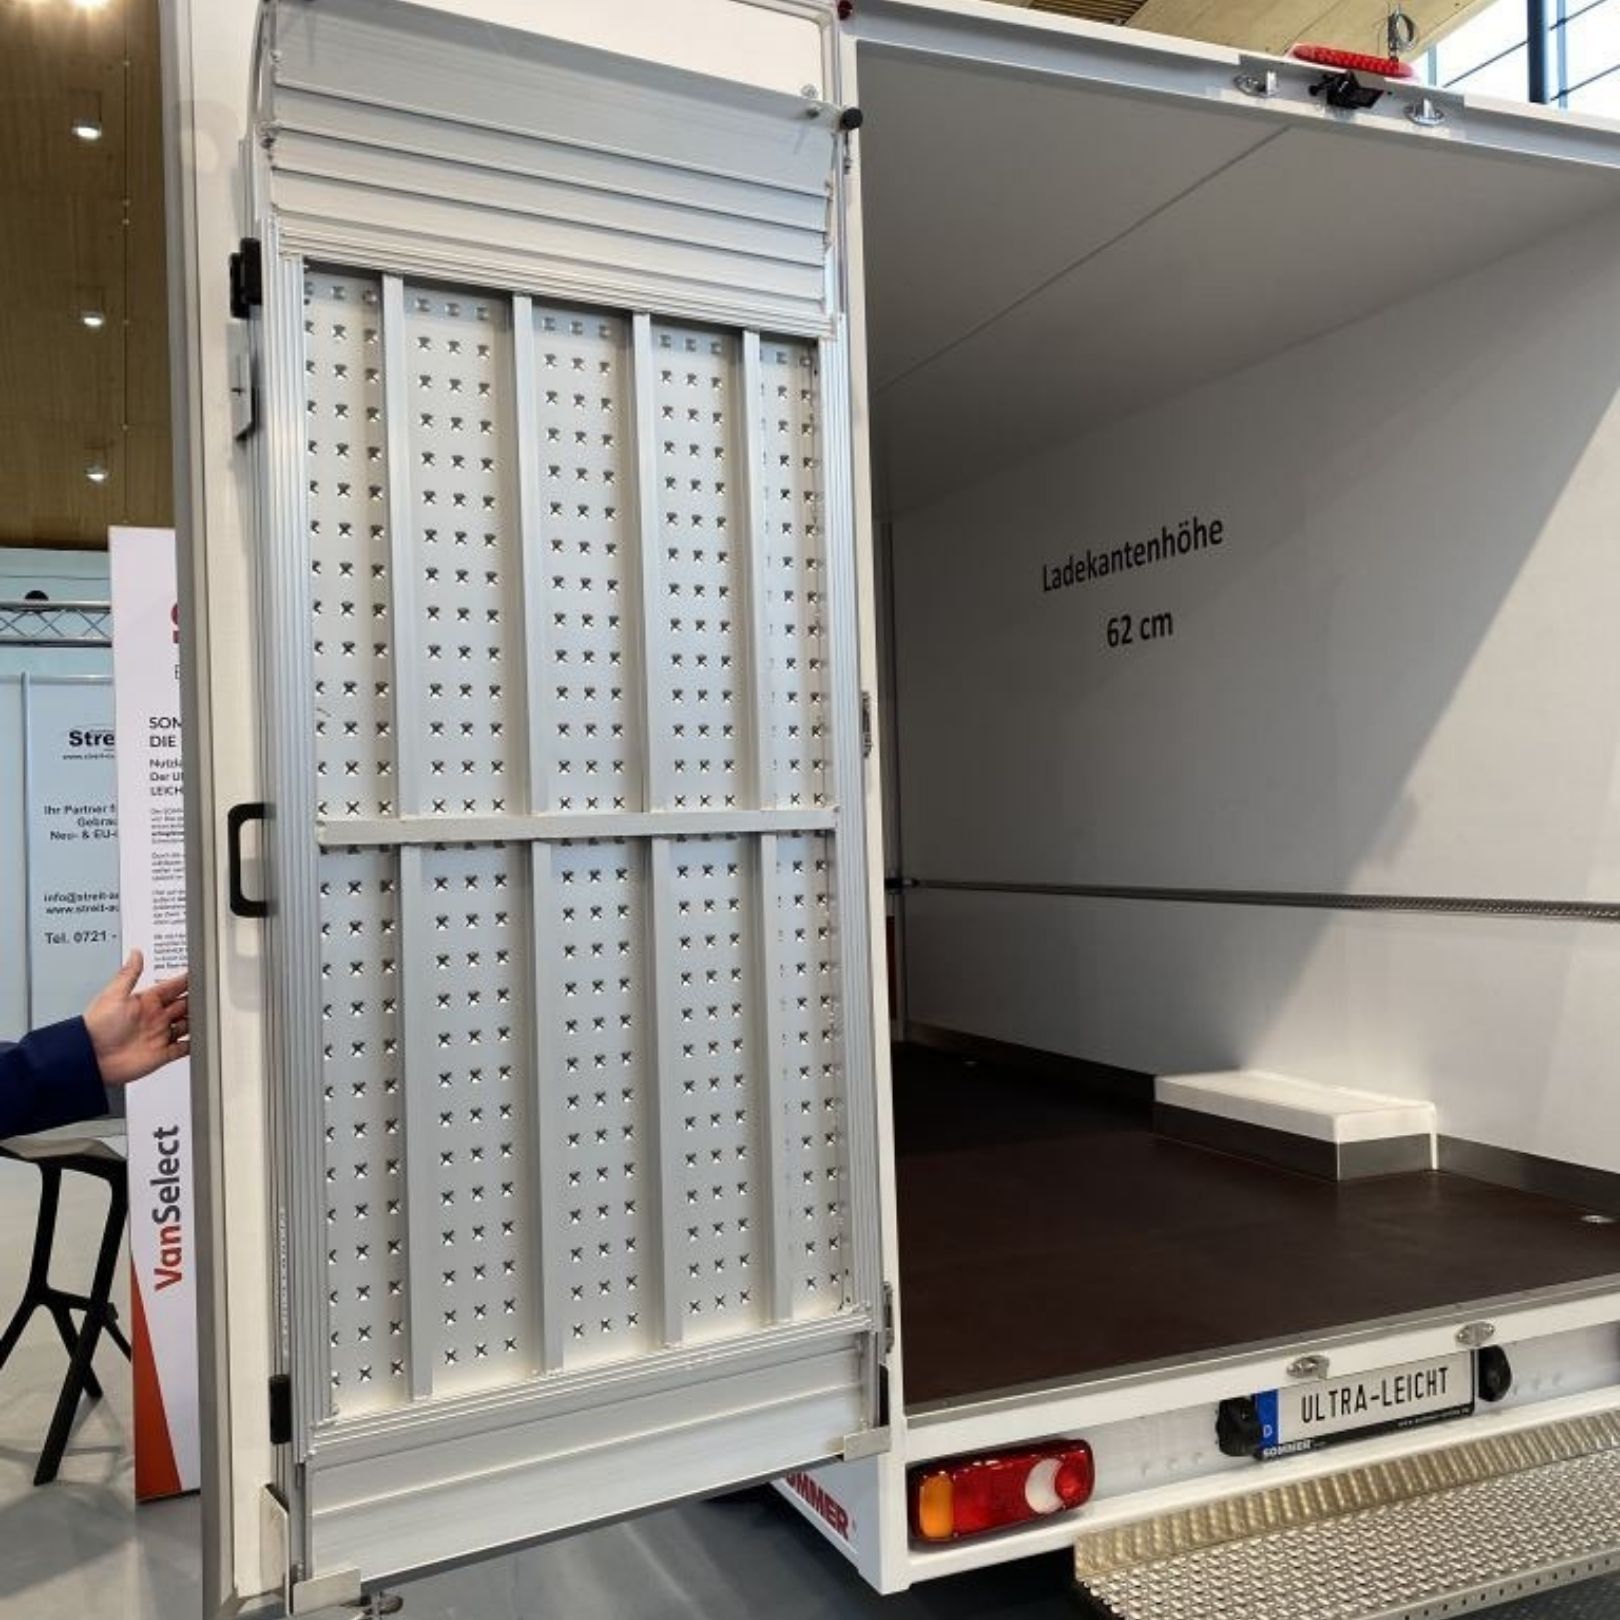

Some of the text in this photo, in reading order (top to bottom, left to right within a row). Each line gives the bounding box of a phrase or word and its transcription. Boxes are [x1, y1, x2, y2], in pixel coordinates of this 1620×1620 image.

[1042, 516, 1224, 593] Ladekantenhöhe
[1106, 612, 1174, 648] 62 cm
[149, 735, 177, 748] DIE
[73, 930, 106, 943] 0721
[150, 1124, 183, 1291] VanSelect
[1301, 1366, 1449, 1423] ULTRA-LEICHT
[1263, 1424, 1273, 1438] D
